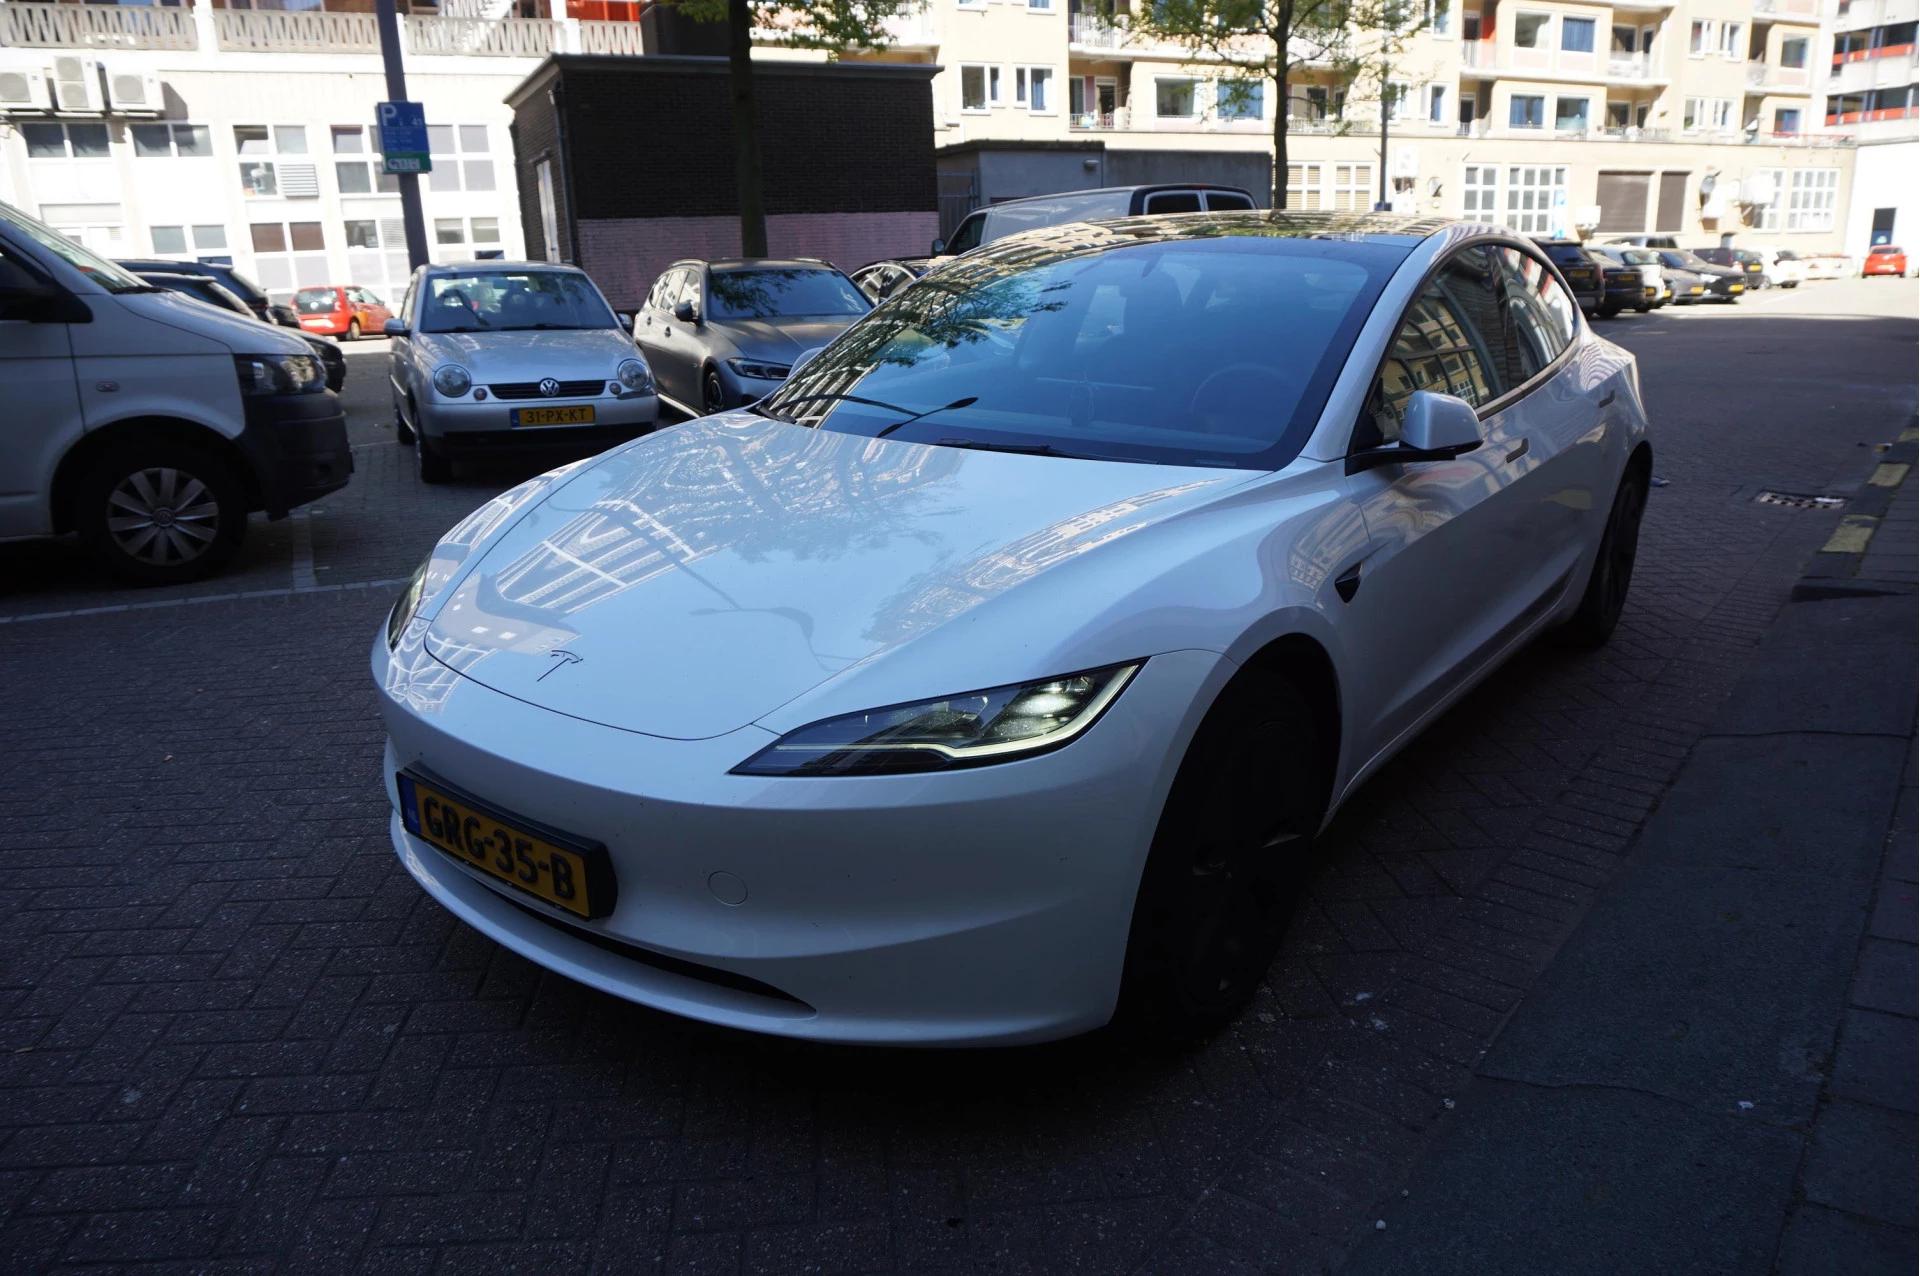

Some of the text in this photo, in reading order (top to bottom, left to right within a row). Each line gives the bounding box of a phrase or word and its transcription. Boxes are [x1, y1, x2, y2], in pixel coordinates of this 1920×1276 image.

[380, 104, 397, 126] P
[526, 408, 586, 423] 31-PX-KT
[423, 796, 576, 899] GRG-35-B
